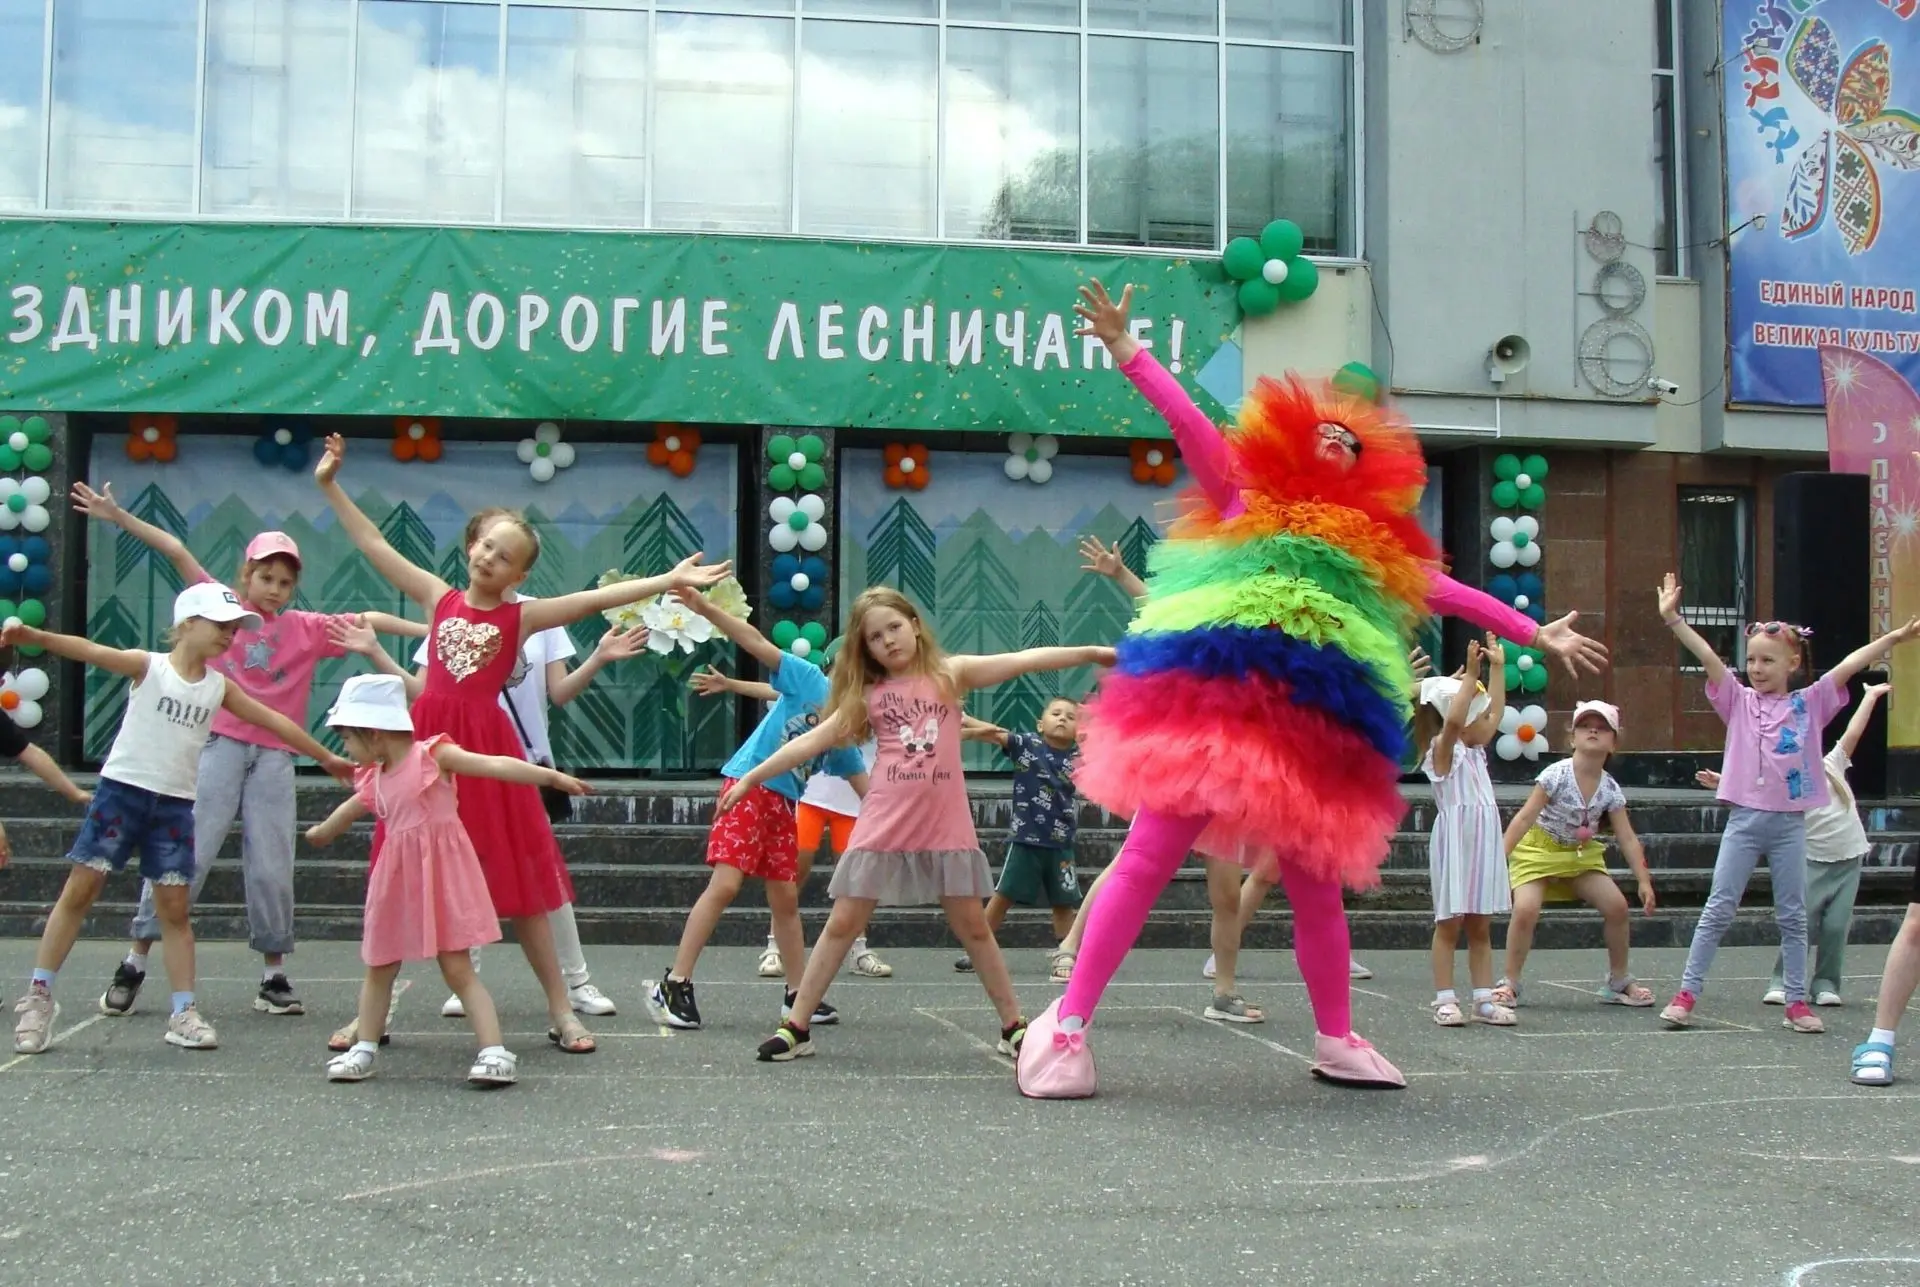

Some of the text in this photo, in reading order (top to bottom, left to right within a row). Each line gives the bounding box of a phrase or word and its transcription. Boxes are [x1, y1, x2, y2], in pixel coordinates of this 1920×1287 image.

[1760, 281, 1916, 312] ЕДИНЫЙ НАРОД
[9, 284, 377, 357] ЗДНИКОМ,
[414, 292, 729, 355] ДОРОГИЕ
[1754, 324, 1840, 347] ВЕЛИКАЯ
